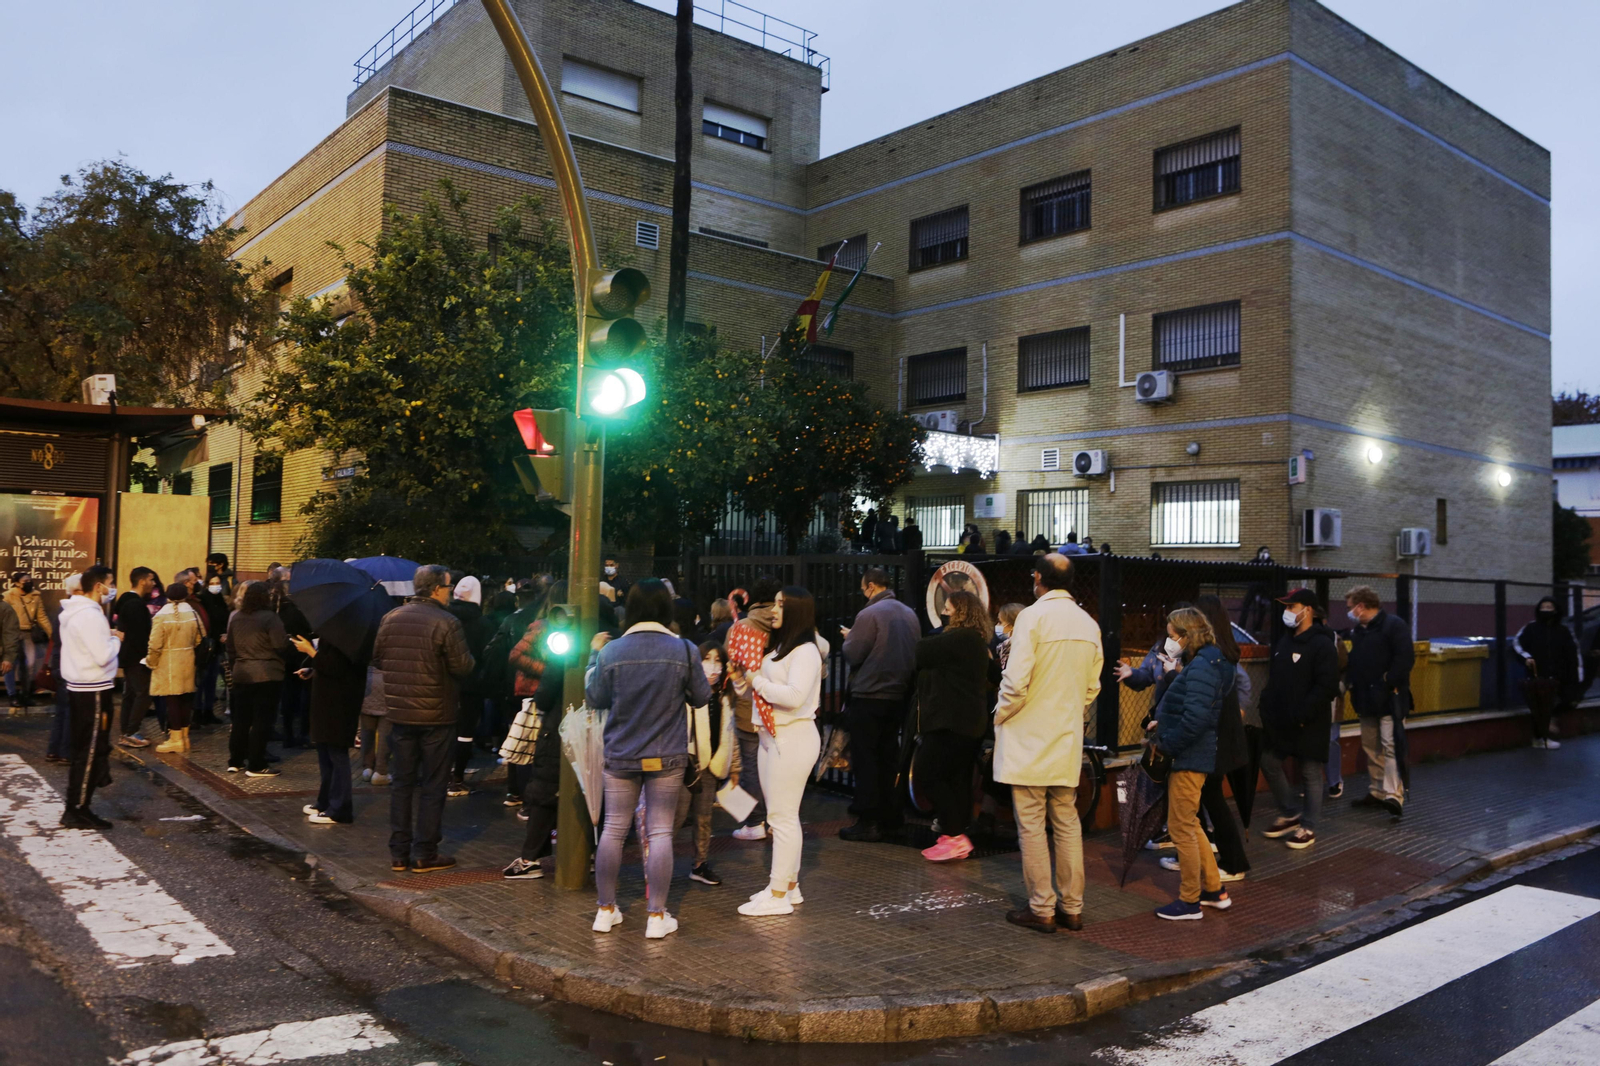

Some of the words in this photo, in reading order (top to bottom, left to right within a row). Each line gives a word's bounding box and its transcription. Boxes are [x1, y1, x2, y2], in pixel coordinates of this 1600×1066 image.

[15, 535, 75, 547] Volvamos
[13, 546, 49, 558] llevar
[52, 547, 88, 560] juntos
[16, 557, 29, 568] la
[32, 557, 72, 569] ilusión
[940, 561, 972, 576] EXCEPTO
[38, 580, 67, 591] ciud
